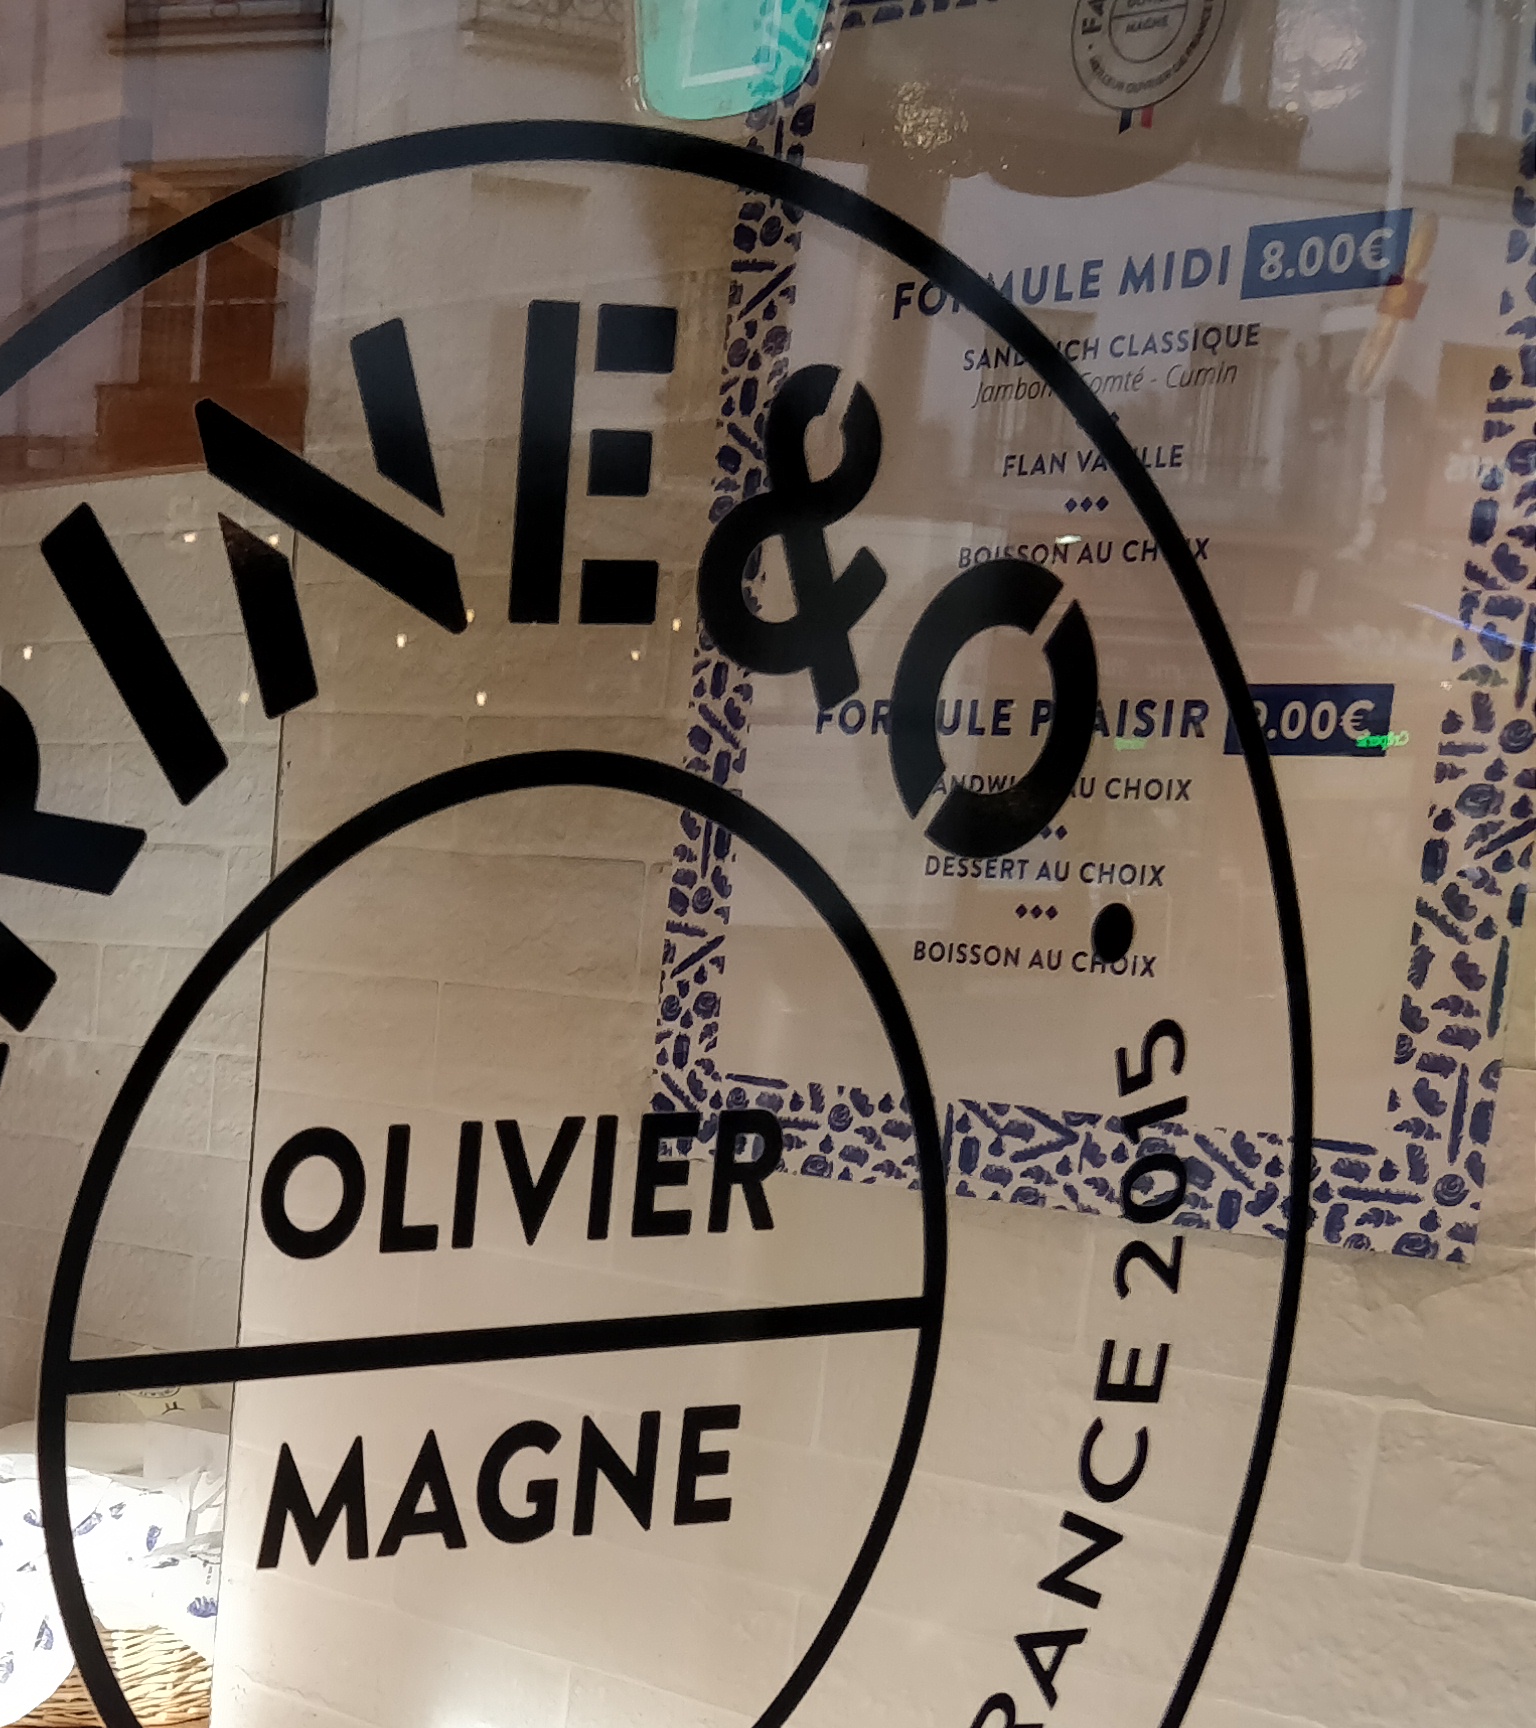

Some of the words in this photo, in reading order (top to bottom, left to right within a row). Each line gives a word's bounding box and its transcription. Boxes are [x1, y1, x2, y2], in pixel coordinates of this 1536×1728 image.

[893, 259, 1103, 320] FOULE
[1119, 245, 1231, 295] MIDI
[1258, 227, 1394, 281] 8.00€
[963, 337, 1100, 371] SANDCH
[1109, 323, 1261, 358] CLASSIQUE
[1167, 362, 1238, 391] Cumin
[1002, 451, 1067, 477] FLAN
[1078, 445, 1185, 472] VALLE
[958, 543, 1069, 568] BOISSON
[1077, 541, 1113, 565] AU
[1122, 538, 1210, 562] CHX
[815, 698, 1015, 737] FORULE
[1030, 698, 1209, 739] PAISIR
[1105, 777, 1193, 801] CHOIX
[924, 855, 1030, 881] DESSERT
[1035, 860, 1071, 882] AU
[1079, 862, 1166, 887] CHOIX
[913, 940, 1021, 968] BOISSON
[1028, 949, 1063, 971] AU
[1071, 951, 1158, 978] CHOIX
[1115, 1017, 1189, 1299] 2015
[260, 1110, 782, 1260] OLIVIER
[257, 1405, 741, 1568] MAGNE
